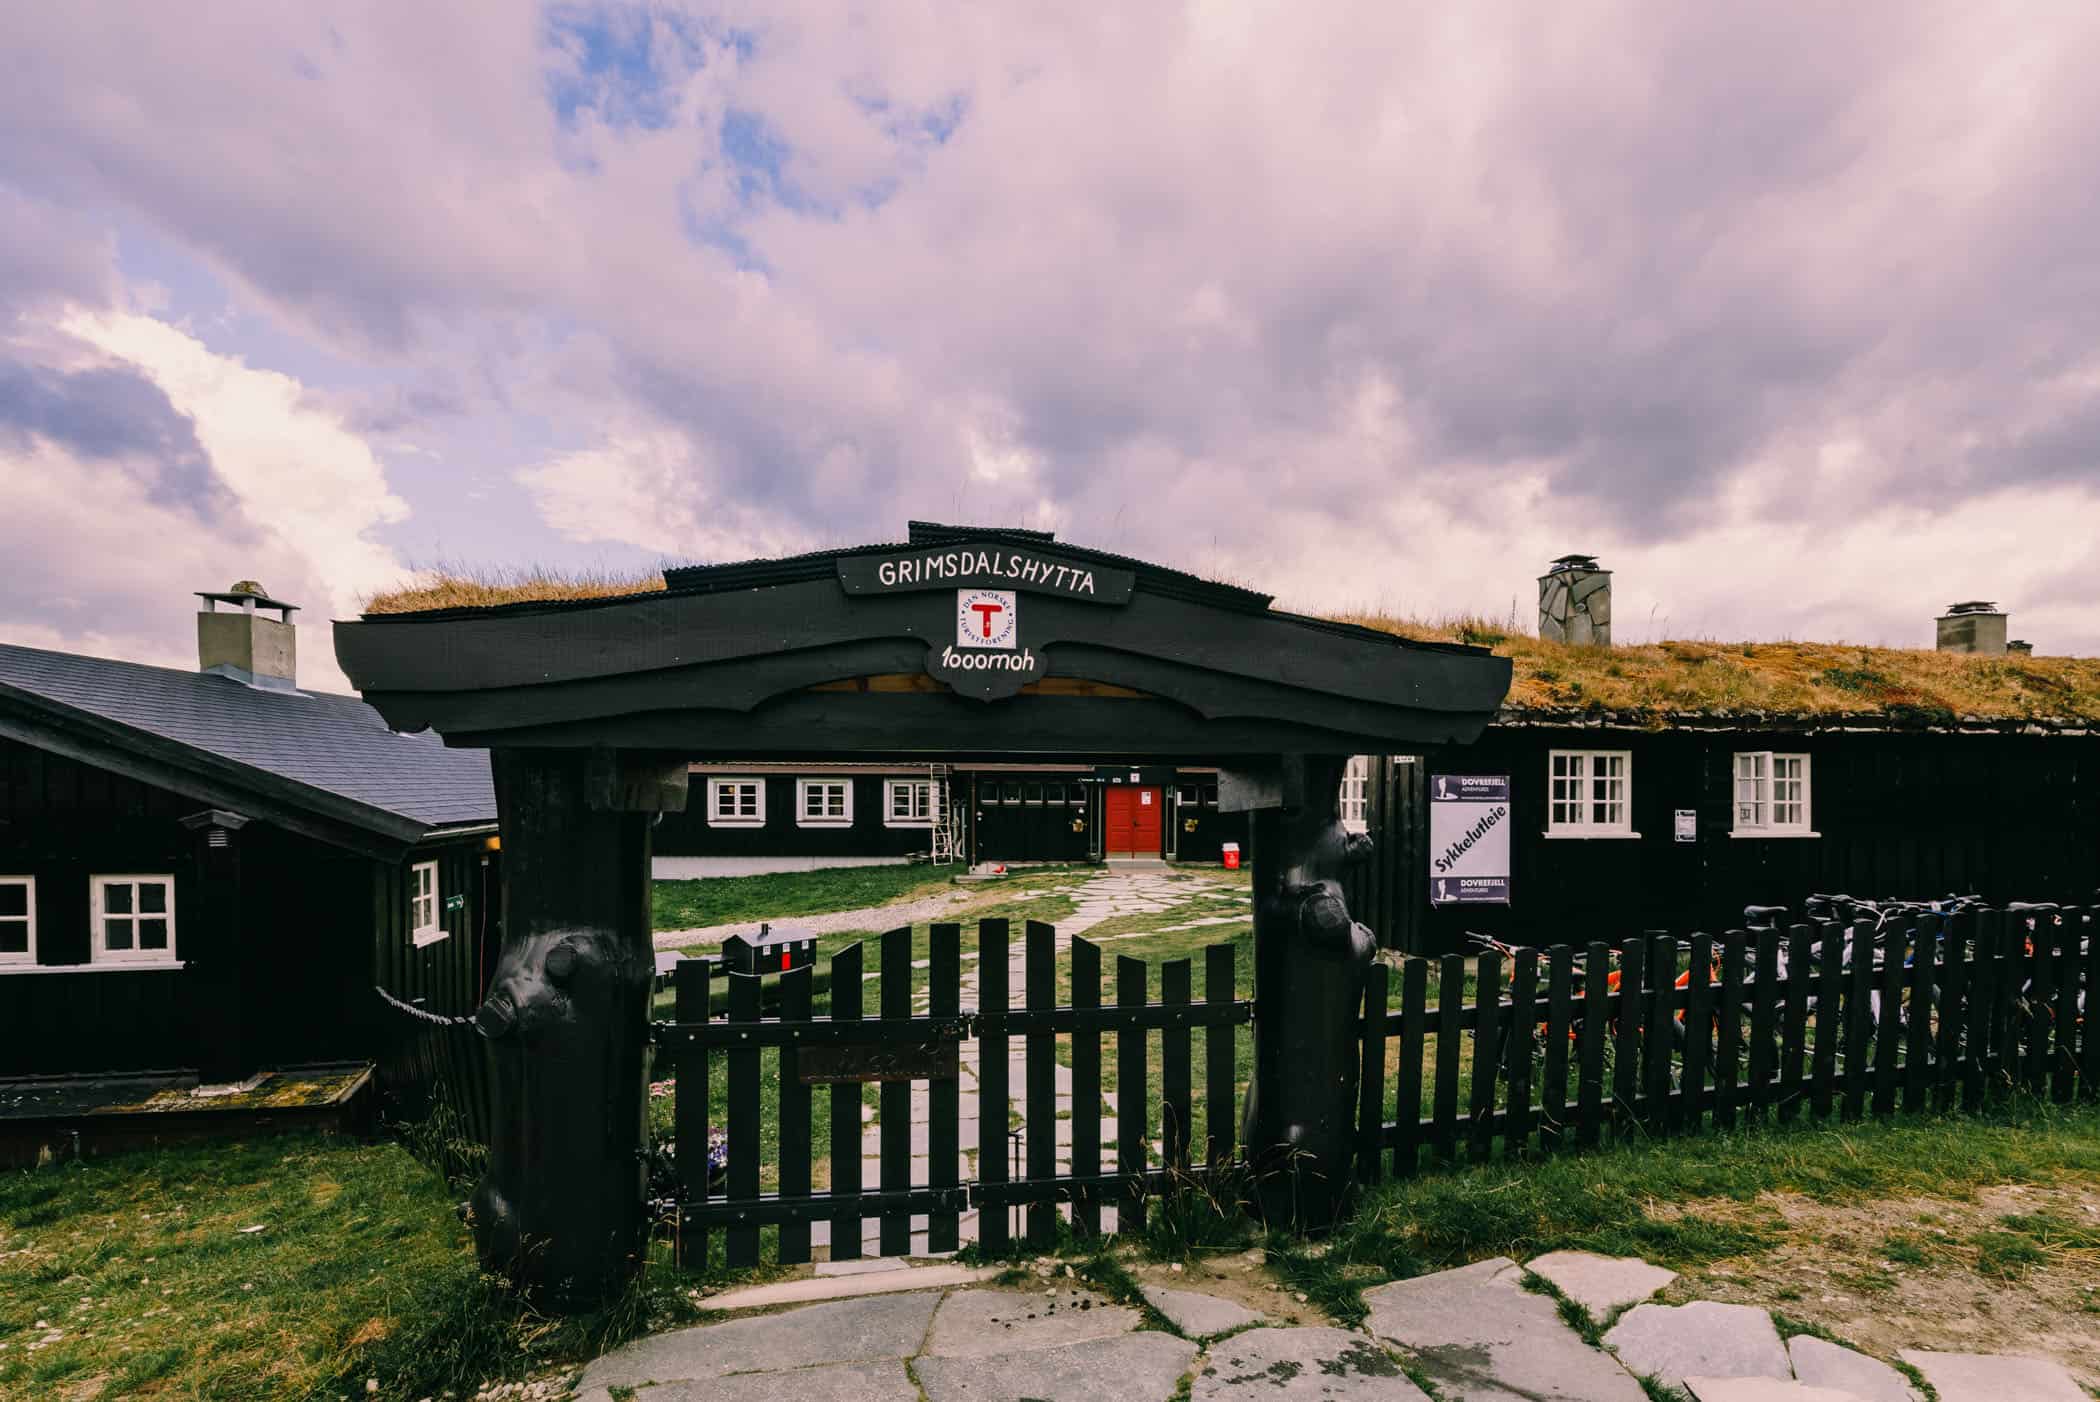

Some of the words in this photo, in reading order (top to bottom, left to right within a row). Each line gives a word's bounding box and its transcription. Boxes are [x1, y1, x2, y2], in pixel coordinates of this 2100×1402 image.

[879, 552, 1095, 595] GRIMSDALSHYTTA
[963, 594, 978, 609] DEN
[981, 591, 1011, 610] NORSKE
[971, 604, 1003, 638] T
[1461, 778, 1506, 786] DOVREFJELL
[1434, 805, 1507, 873] Sykkelutleie
[1460, 879, 1505, 887] DOVREFJELL
